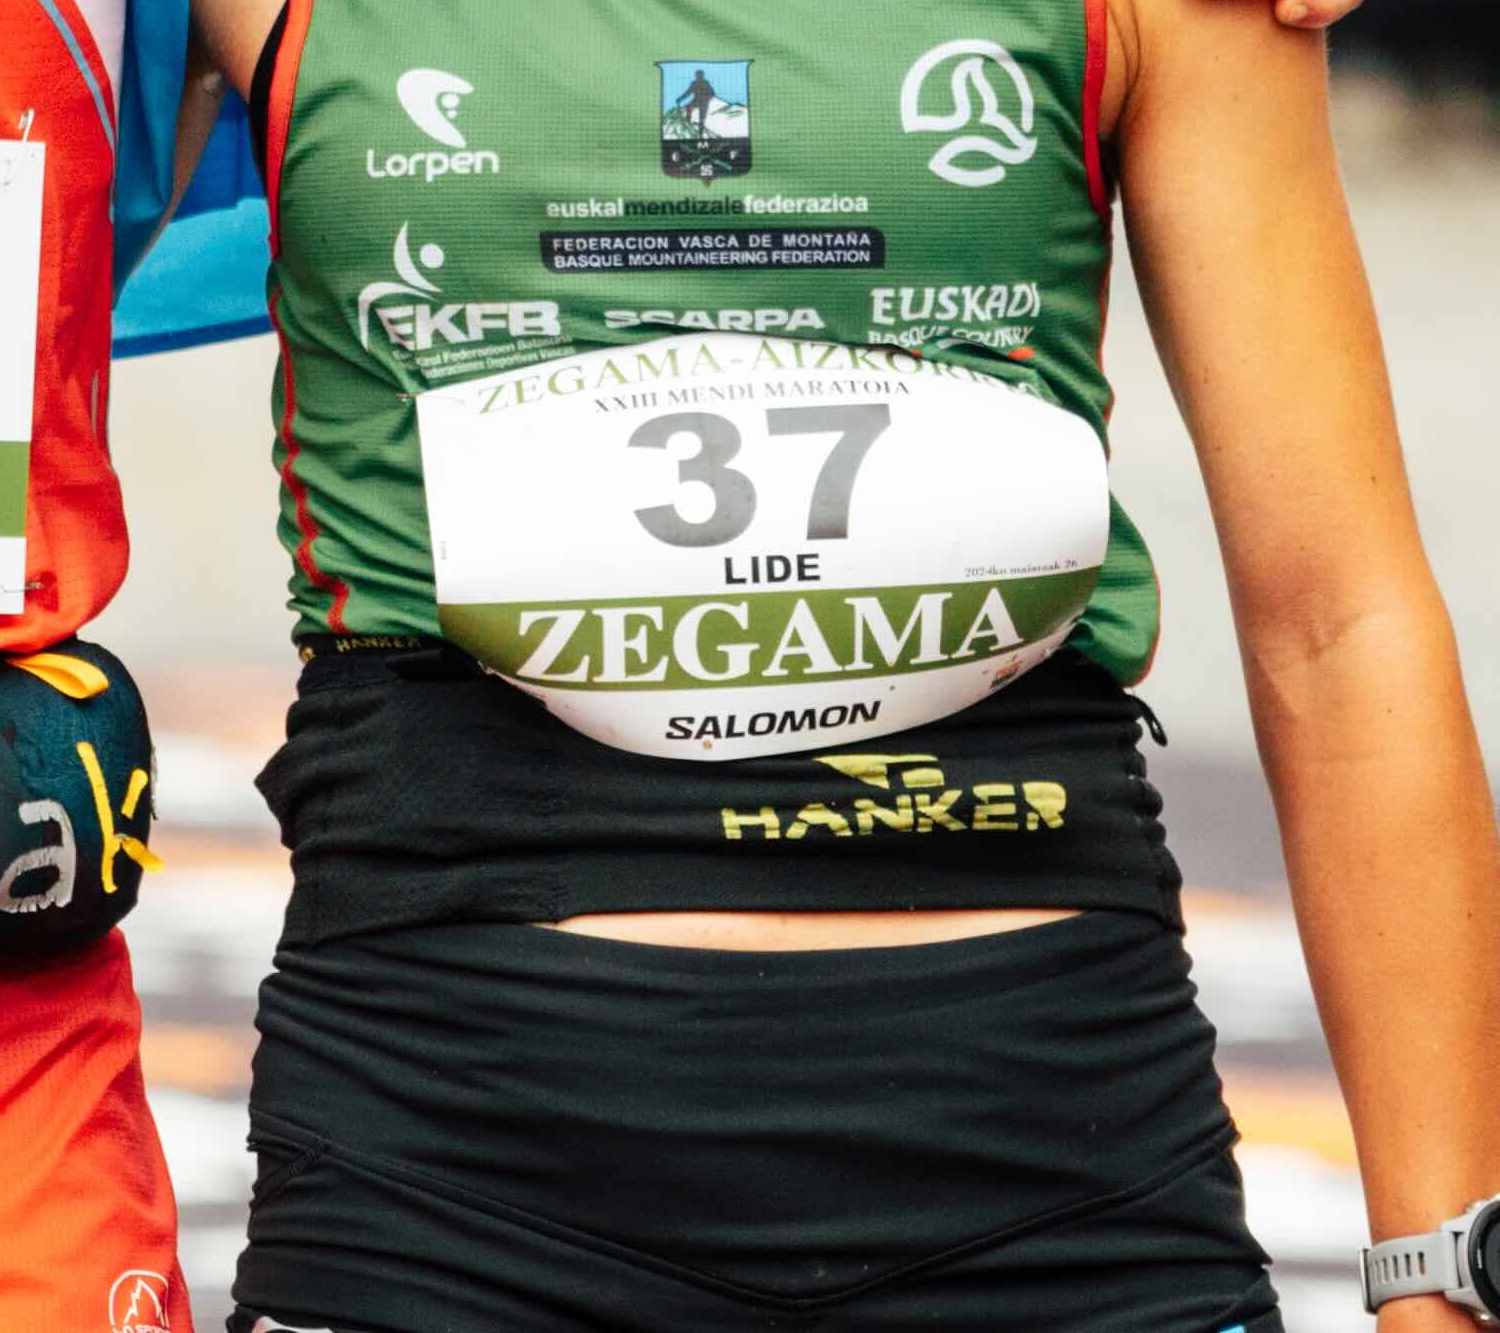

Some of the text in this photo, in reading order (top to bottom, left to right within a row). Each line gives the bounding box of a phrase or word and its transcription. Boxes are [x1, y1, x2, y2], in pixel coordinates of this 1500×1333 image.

[366, 147, 500, 183] Lorpen
[552, 230, 871, 253] FEDERACION VASCA DE MONTAÑA
[554, 249, 871, 270] BASQUE MOUNTAINEERING FEDERATION
[870, 282, 1042, 326] EUSKADI
[593, 376, 912, 415] XXIII MENDI MARATOIA
[625, 402, 892, 550] 37
[723, 552, 823, 586] LIDE
[516, 586, 1026, 686] ZEGAMA
[665, 699, 884, 743] SALOMON
[720, 780, 1068, 841] HANKER
